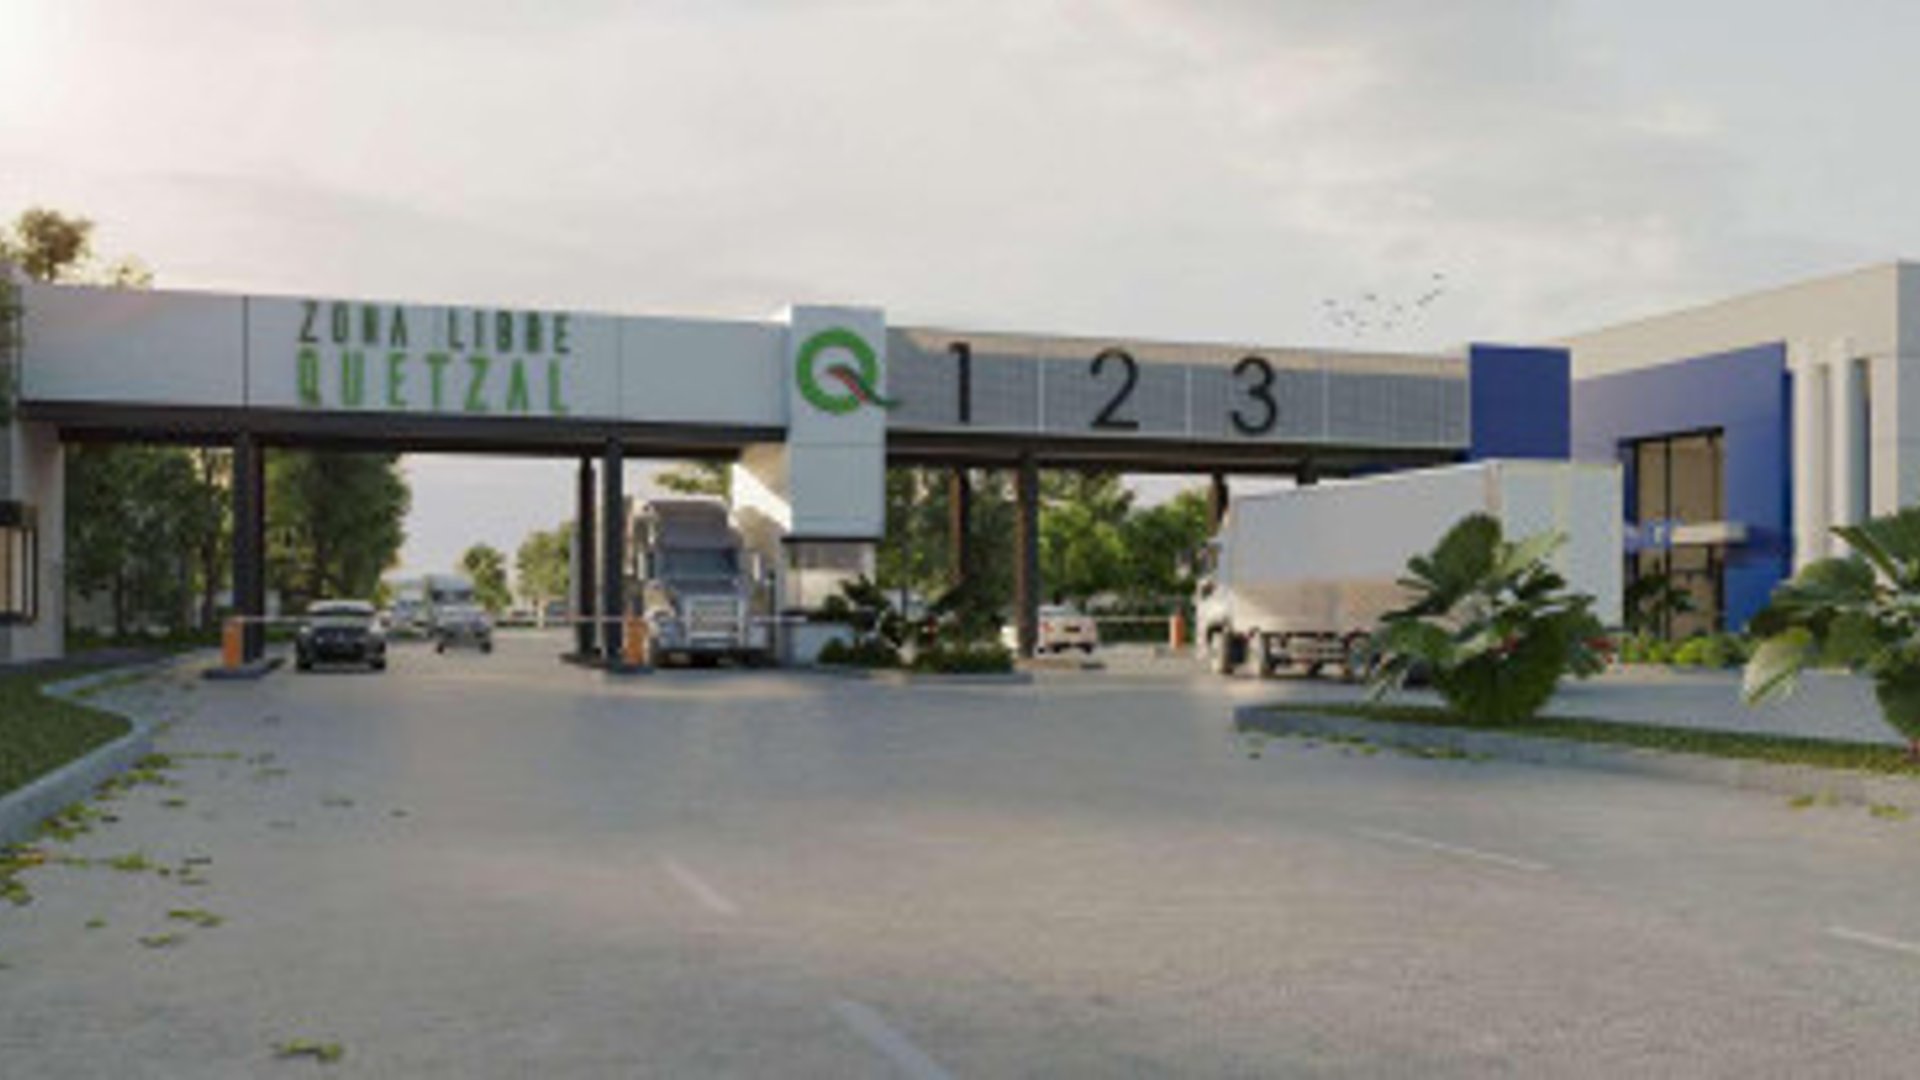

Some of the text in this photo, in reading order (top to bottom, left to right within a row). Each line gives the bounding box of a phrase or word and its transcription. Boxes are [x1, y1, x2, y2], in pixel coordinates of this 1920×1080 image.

[297, 348, 569, 413] QUETZAL
[949, 342, 1279, 436] 1 2 3
